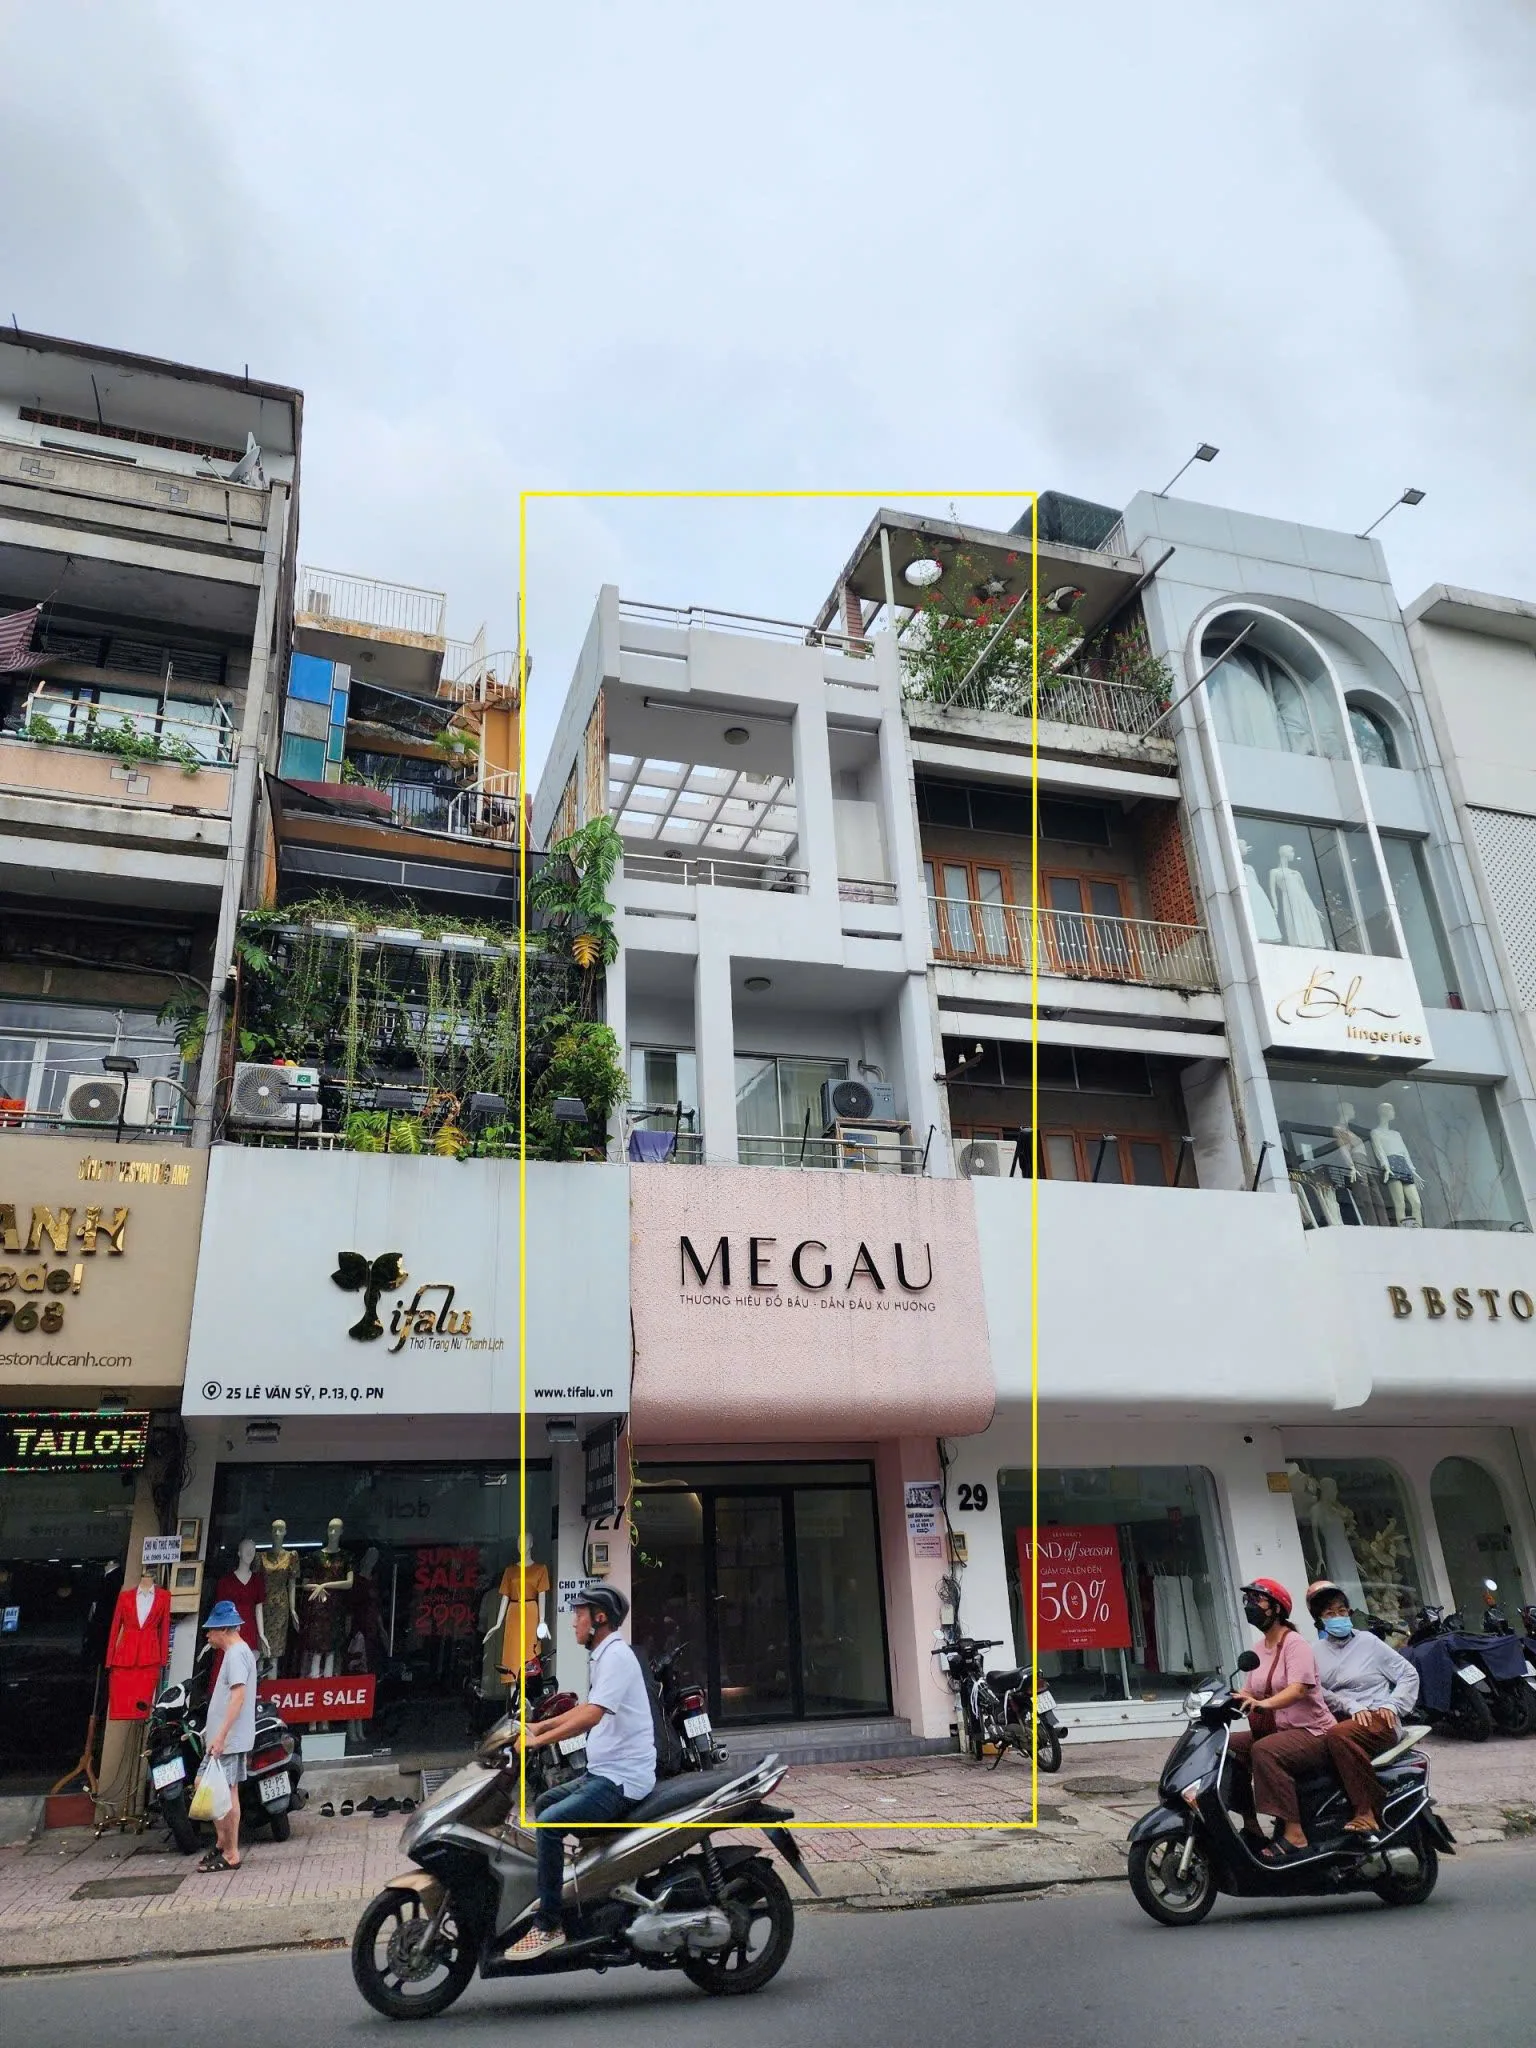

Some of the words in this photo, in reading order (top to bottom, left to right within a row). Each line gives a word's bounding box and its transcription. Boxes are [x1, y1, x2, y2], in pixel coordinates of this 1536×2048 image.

[1347, 1026, 1422, 1045] lingeries
[680, 1235, 932, 1291] MEGAU
[428, 1337, 449, 1353] Trang
[465, 1337, 487, 1350] Thanh
[0, 1351, 132, 1367] estonducanh.com
[226, 1387, 241, 1399] 25
[245, 1385, 261, 1399] LÊ
[265, 1385, 291, 1399] VĂN
[295, 1384, 315, 1400] SỸ,
[366, 1387, 384, 1399] PN
[534, 1386, 613, 1398] www.tifalu.vn
[13, 1429, 143, 1456] TAILOR
[957, 1483, 988, 1511] 29
[1063, 1541, 1081, 1561] off
[1079, 1546, 1113, 1556] season
[414, 1566, 480, 1590] SALE
[559, 1580, 576, 1590] CHO
[1039, 1579, 1109, 1622] 50%
[270, 1691, 315, 1709] SALE
[322, 1688, 367, 1706] SALE
